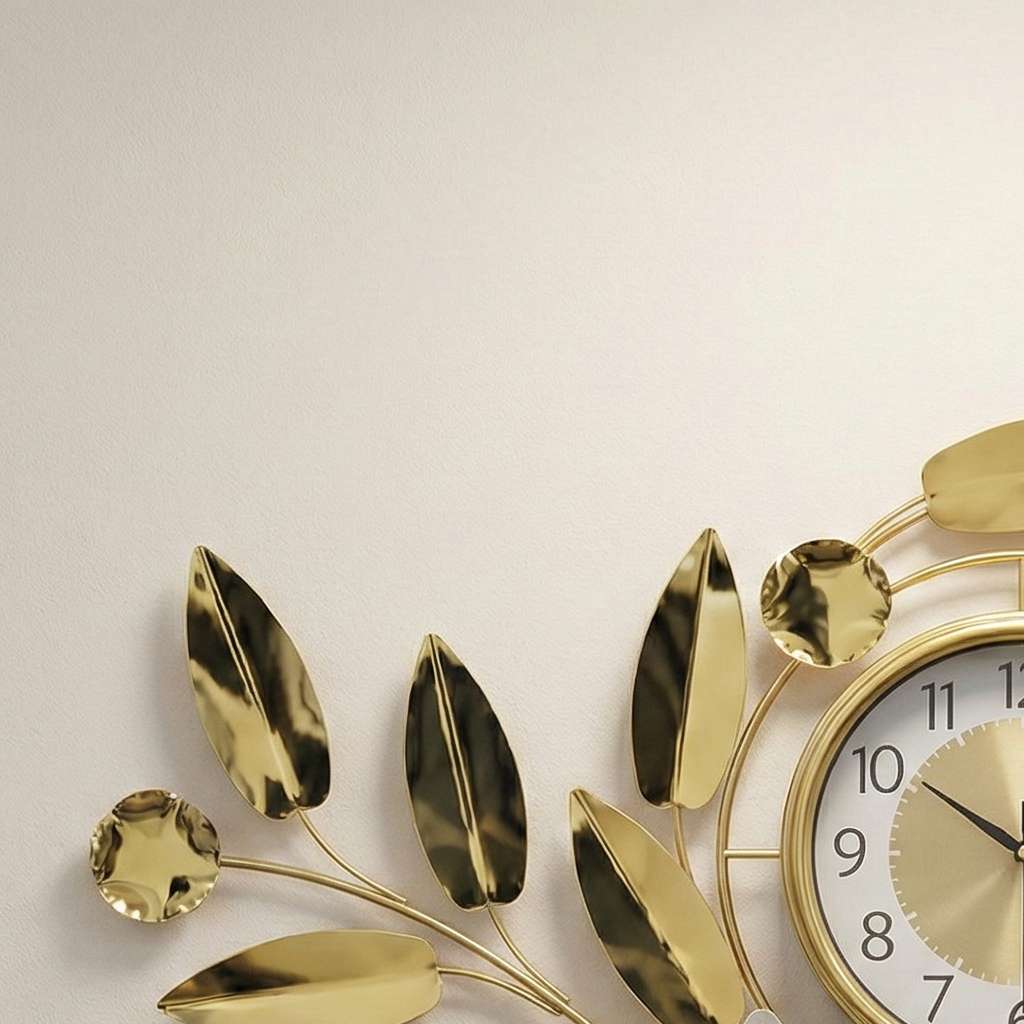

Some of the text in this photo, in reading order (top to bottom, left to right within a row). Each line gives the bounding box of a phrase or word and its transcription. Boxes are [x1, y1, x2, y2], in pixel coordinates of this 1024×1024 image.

[920, 681, 954, 731] 11
[851, 744, 904, 794] 10
[833, 827, 866, 878] 9
[861, 911, 895, 962] 8
[923, 975, 955, 1023] 7
